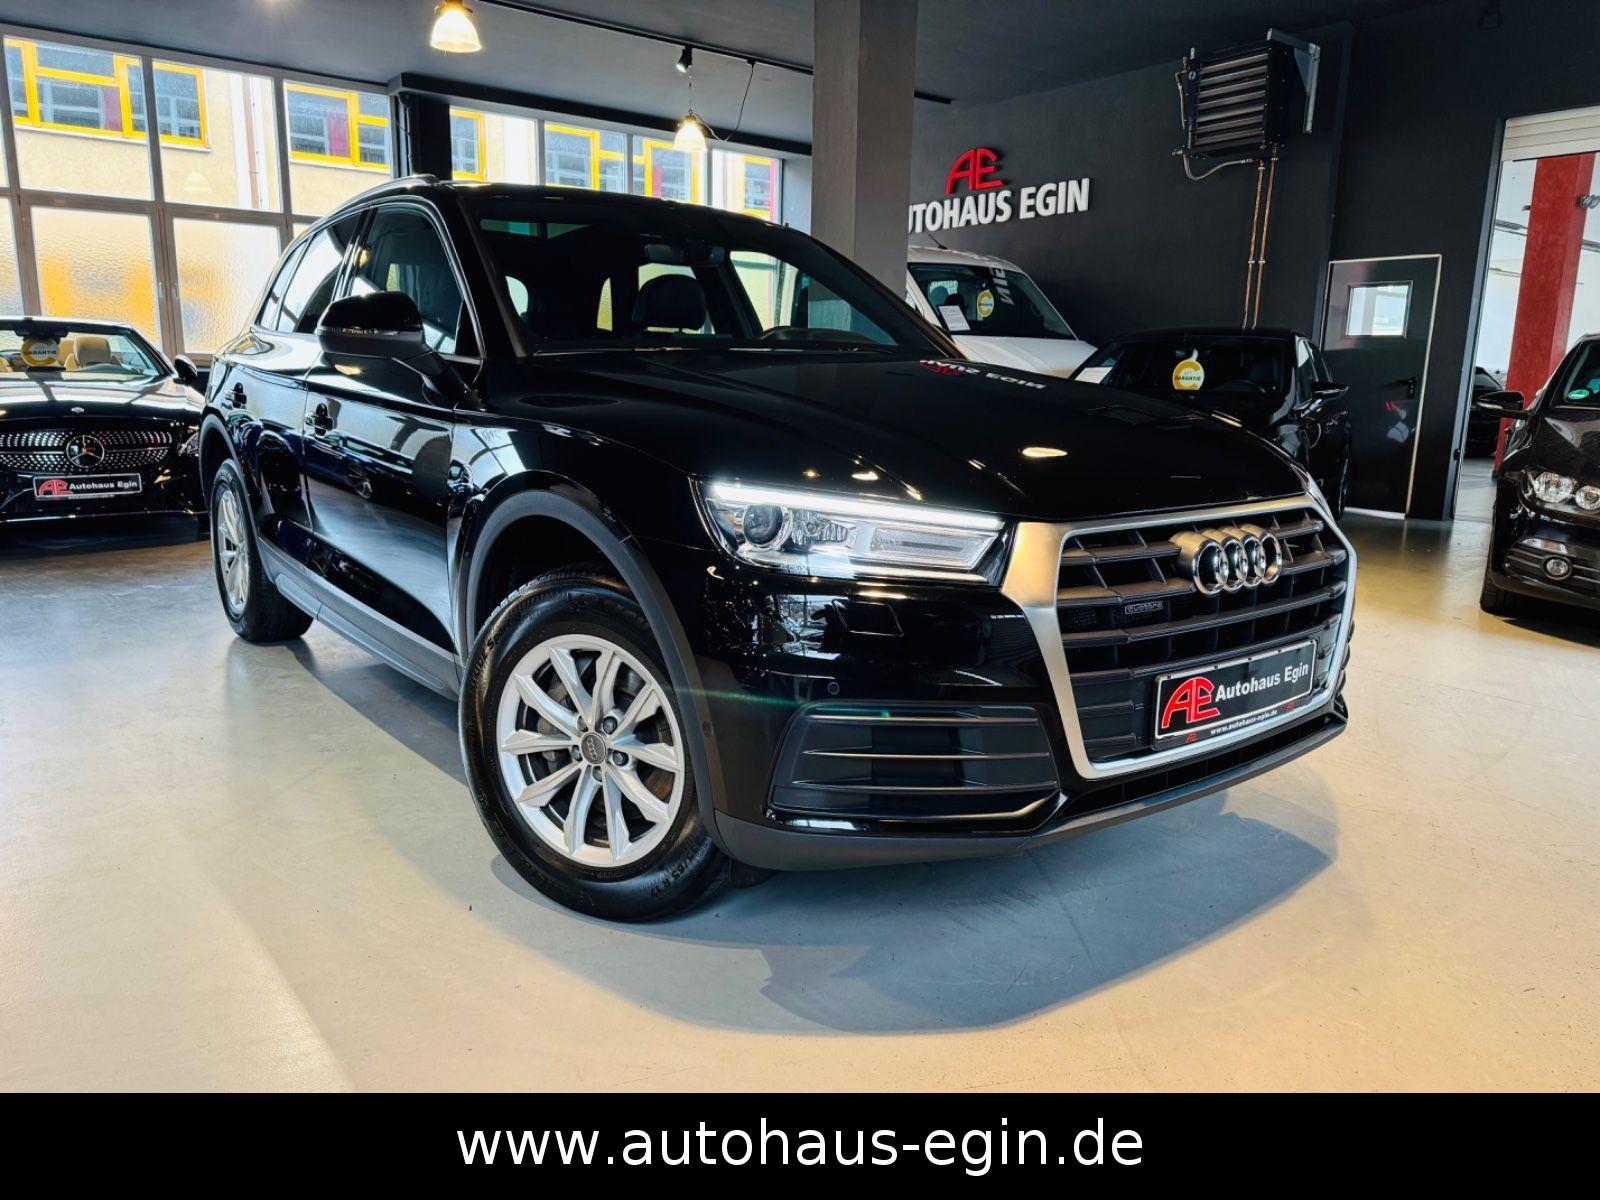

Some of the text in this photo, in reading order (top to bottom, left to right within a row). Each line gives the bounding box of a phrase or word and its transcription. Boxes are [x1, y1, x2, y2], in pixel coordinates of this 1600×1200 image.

[1019, 177, 1090, 220] EGIN
[69, 480, 138, 490] Autohaus Egin
[1215, 662, 1309, 702] Autohaus Egin
